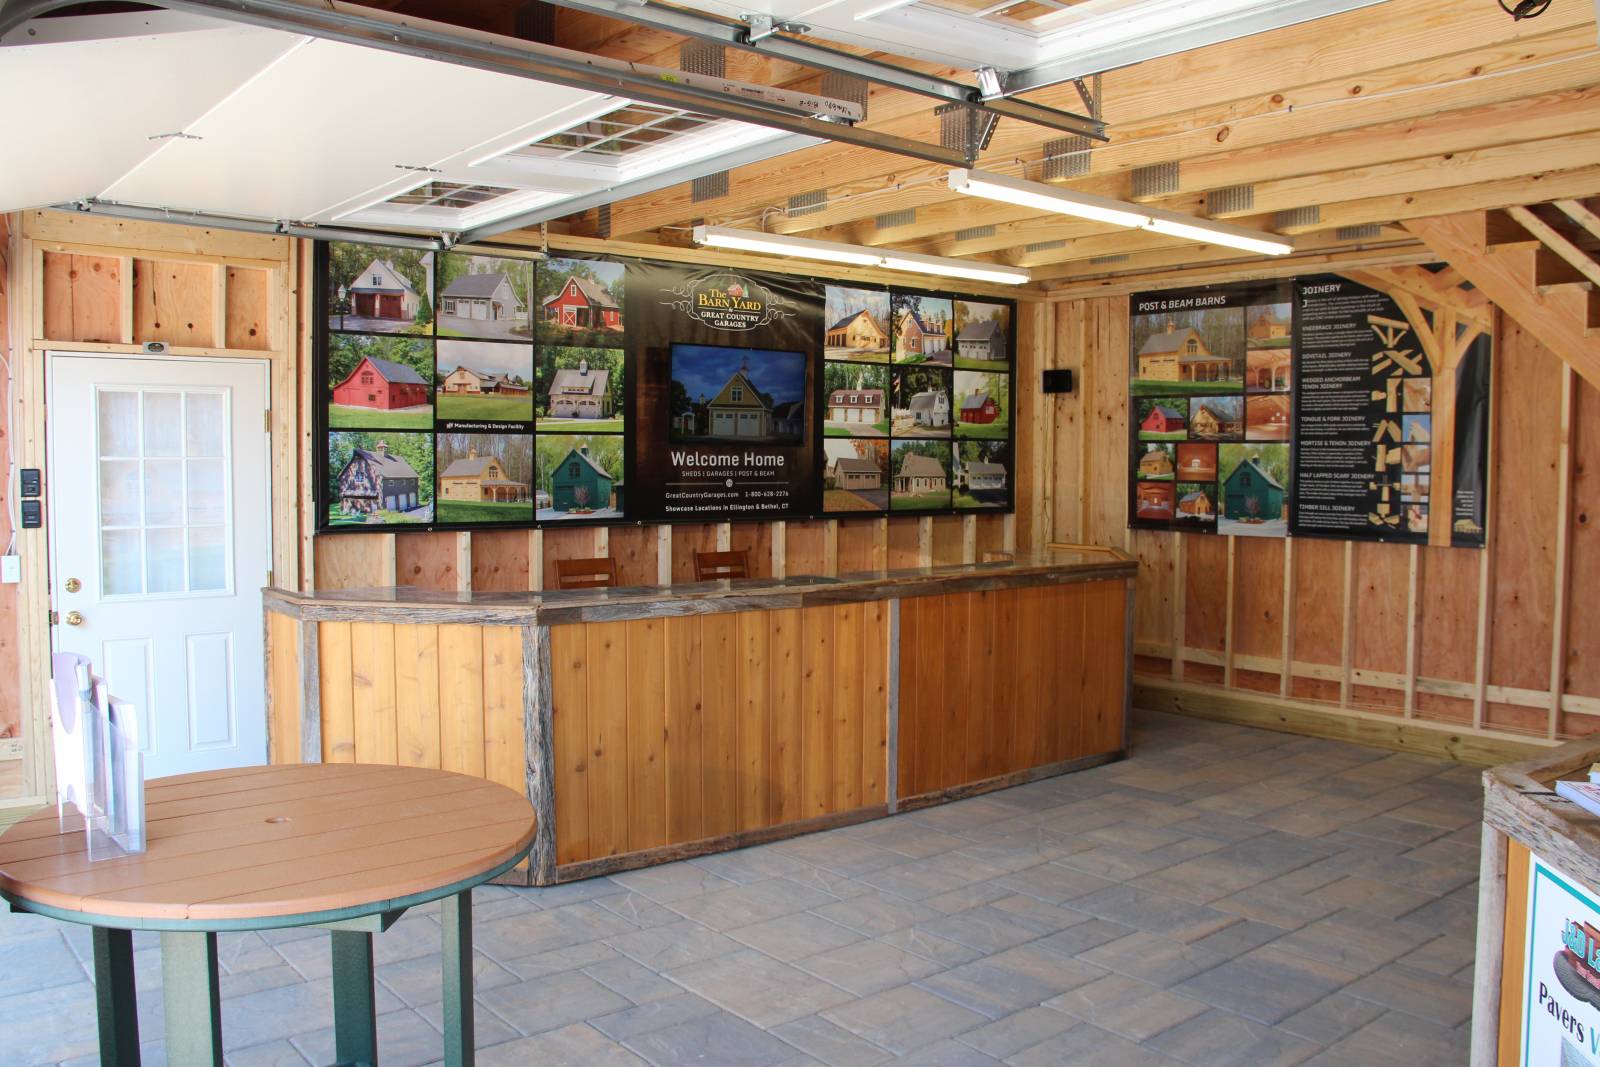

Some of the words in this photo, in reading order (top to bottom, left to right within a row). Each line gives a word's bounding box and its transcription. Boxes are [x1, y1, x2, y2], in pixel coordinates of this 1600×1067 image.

[709, 288, 727, 299] The
[1302, 284, 1342, 296] JOINERY
[698, 293, 730, 308] BARN
[732, 296, 762, 311] YARD
[1139, 302, 1159, 311] POST
[1160, 302, 1167, 310] &
[1168, 298, 1193, 309] BEAM
[1195, 295, 1226, 307] BARNS
[700, 311, 725, 320] GREAT
[726, 313, 759, 322] COUNTRY
[714, 320, 747, 328] GARAGES
[671, 451, 740, 467] Welcome
[744, 451, 785, 466] Home
[665, 491, 739, 500] GreatCountryGarages.com
[695, 504, 722, 512] Locations
[729, 503, 755, 512] Ellington
[1539, 981, 1584, 1043] Pavers
